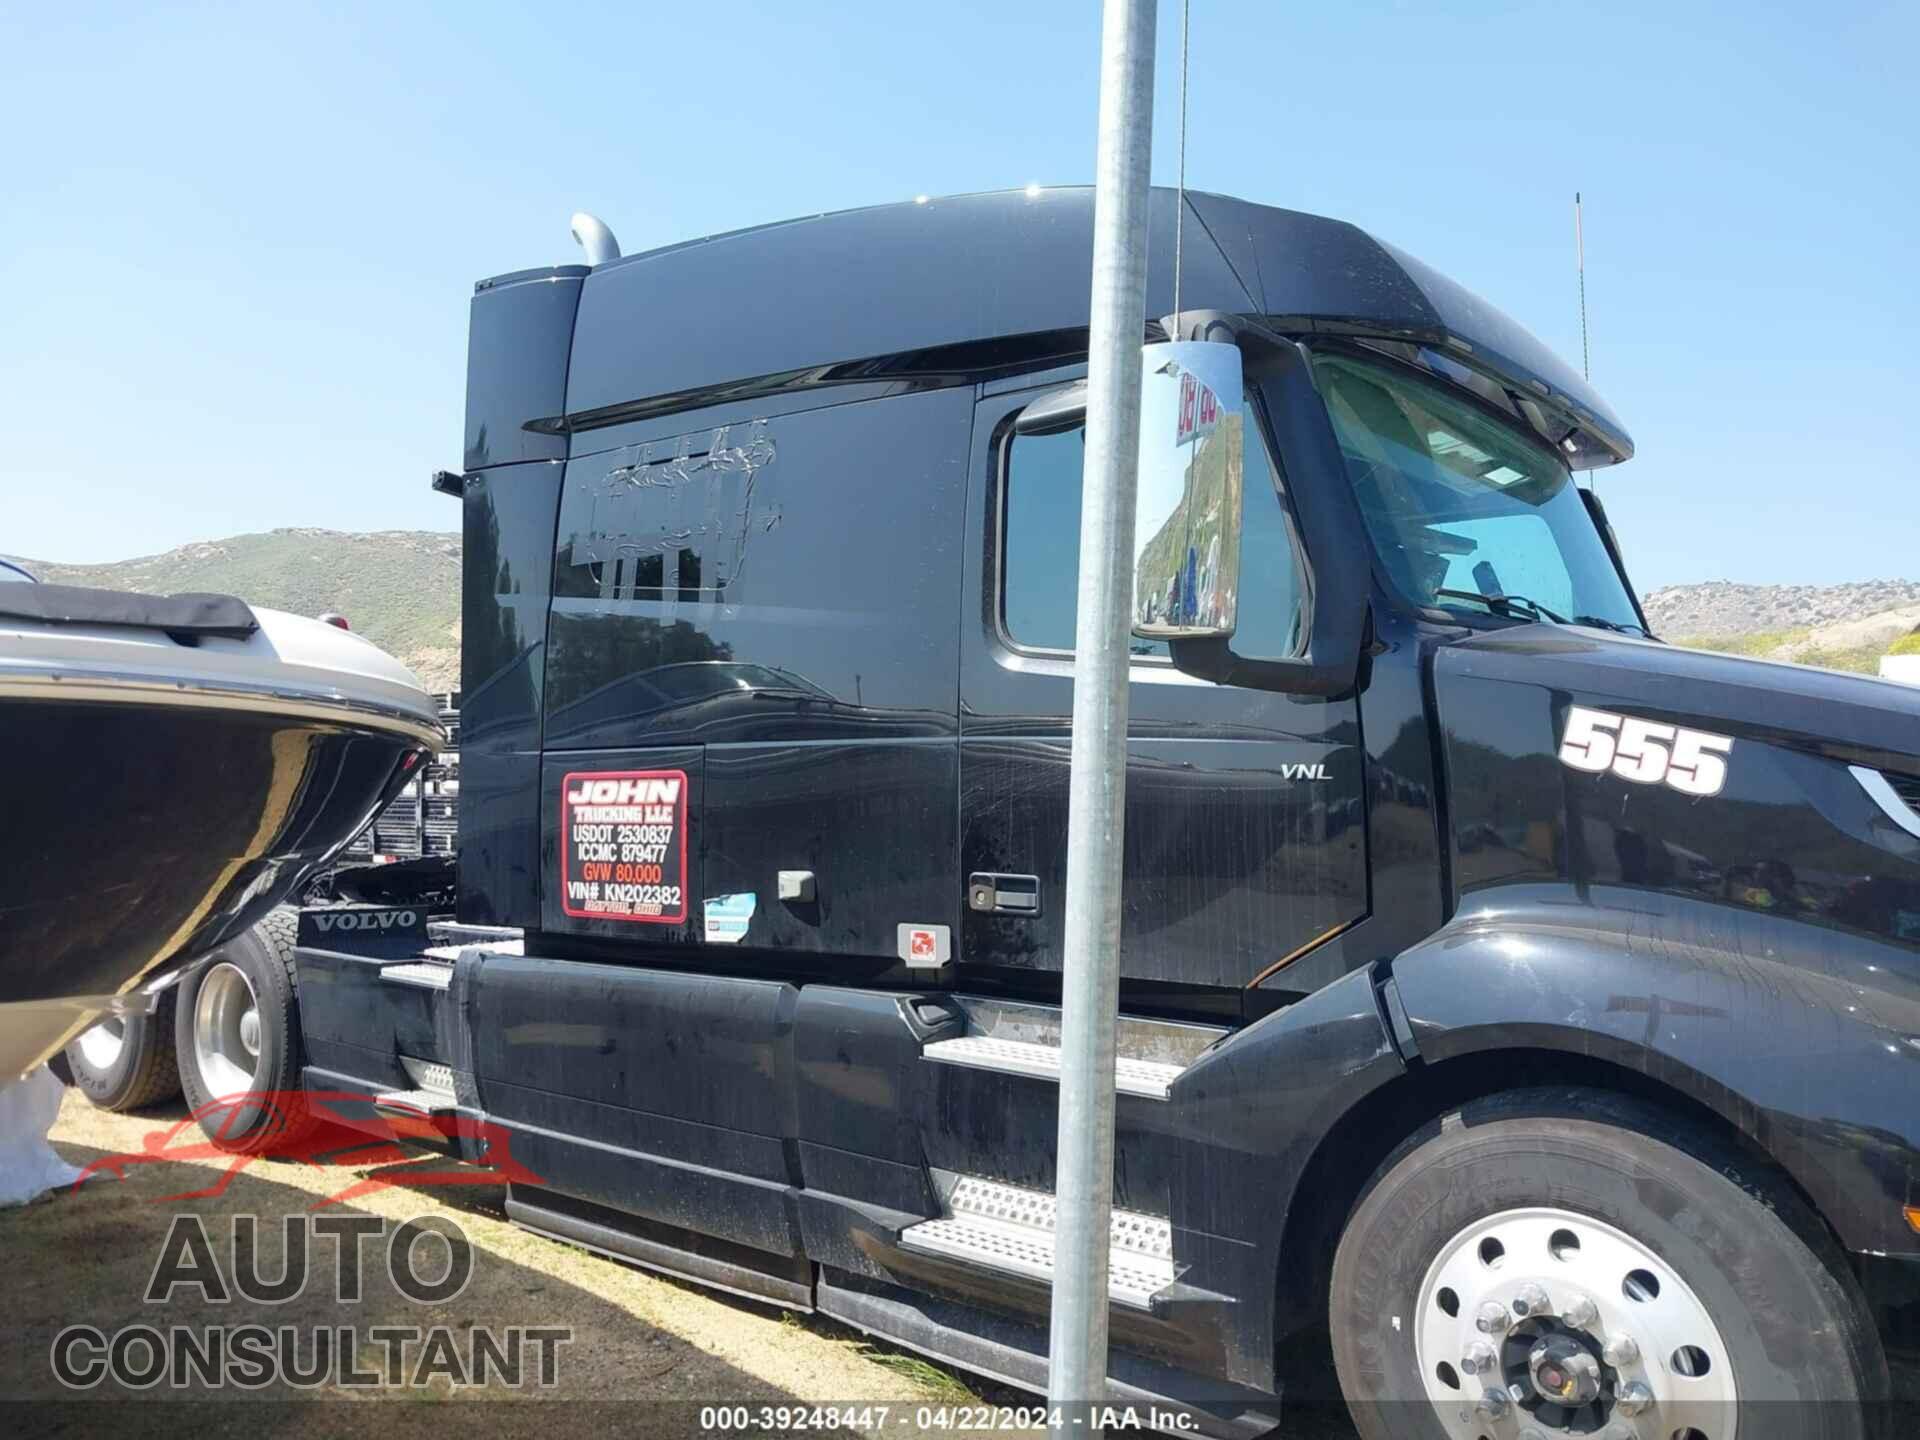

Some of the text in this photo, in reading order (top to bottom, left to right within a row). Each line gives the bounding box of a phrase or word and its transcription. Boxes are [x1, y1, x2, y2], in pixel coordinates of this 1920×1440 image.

[1558, 704, 1735, 796] 555
[1281, 763, 1334, 780] VNL
[567, 779, 681, 804] JOHN
[574, 805, 673, 824] TRUCKING LLC
[573, 825, 673, 844] USDOT 2530837
[578, 843, 667, 863] ICCMC 879477
[584, 864, 661, 883] GVW 80,000
[568, 881, 681, 905] VIN# KN202382
[312, 911, 416, 931] VOLVO
